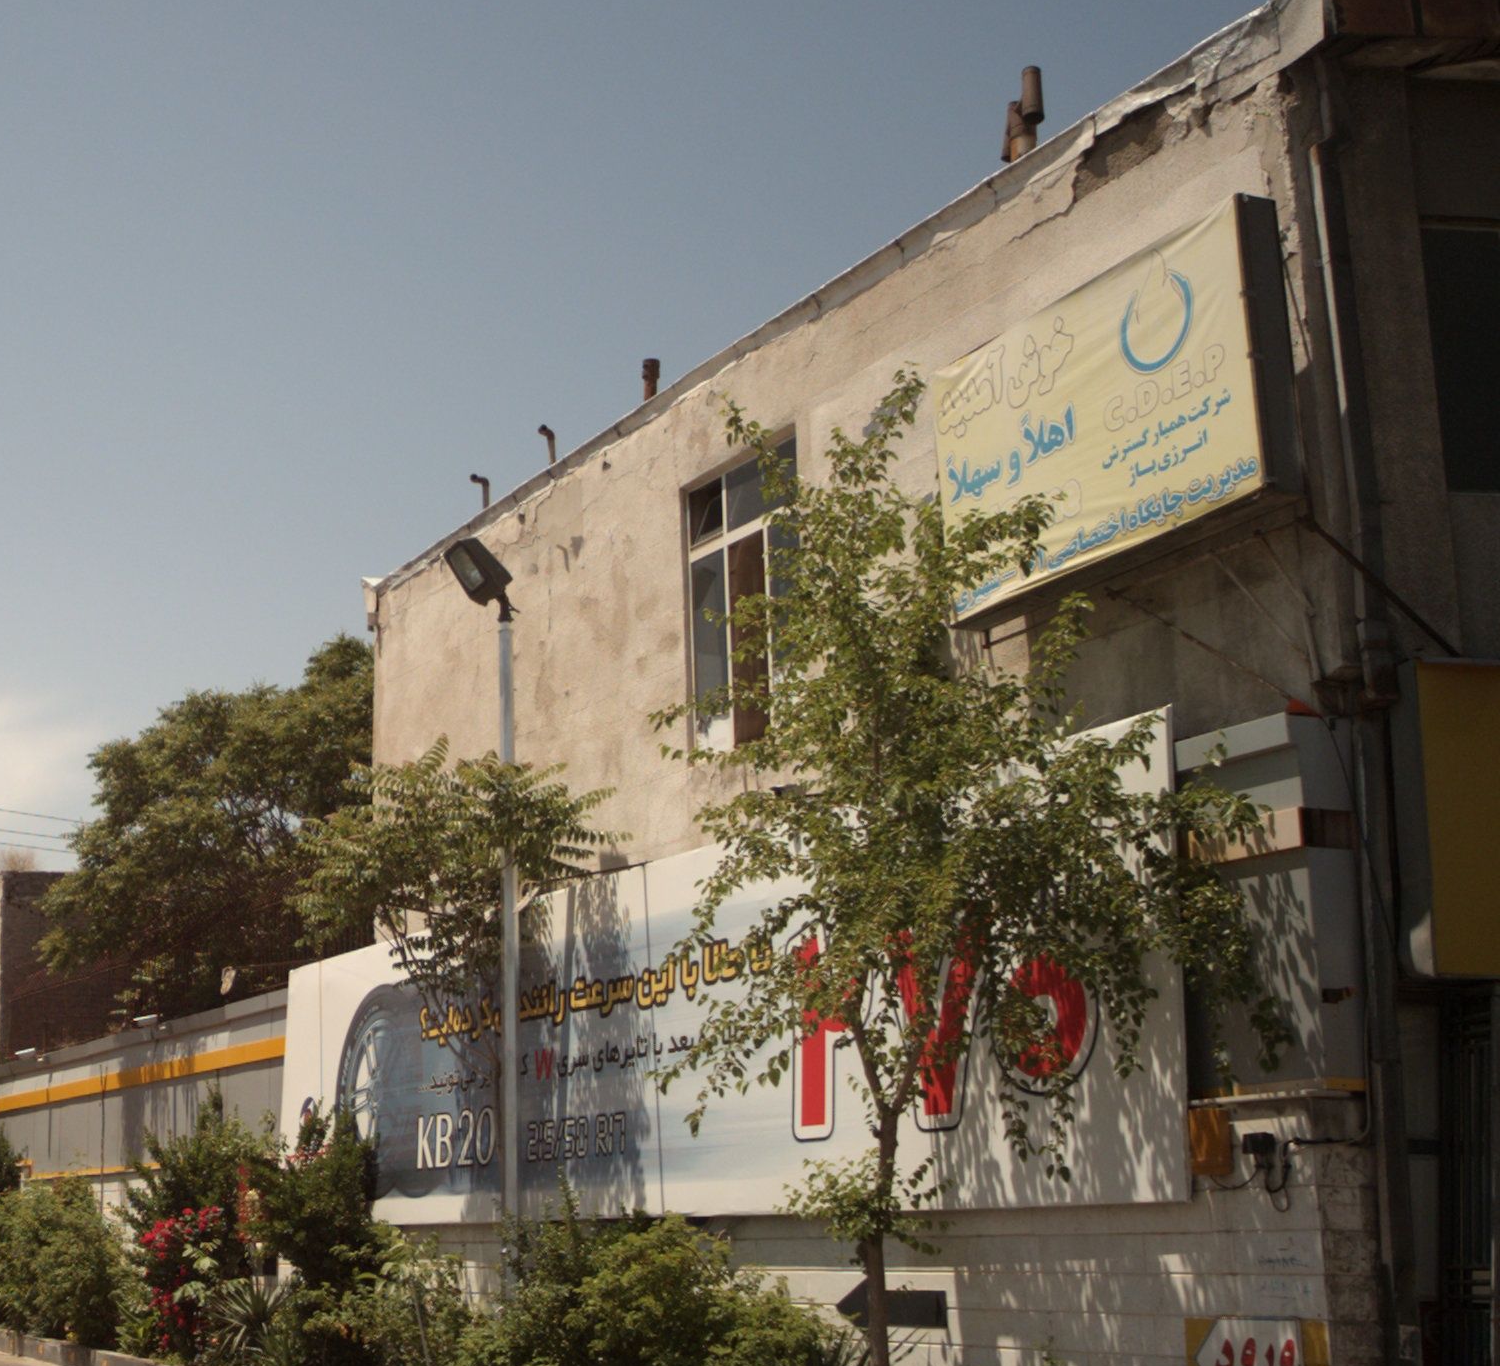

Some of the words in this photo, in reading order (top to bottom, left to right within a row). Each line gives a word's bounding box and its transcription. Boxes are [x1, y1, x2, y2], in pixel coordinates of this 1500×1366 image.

[1104, 344, 1225, 432] C.D.E.P
[1188, 388, 1231, 423] شرکت
[1152, 414, 1188, 447] همیار
[1158, 428, 1207, 472] انرژی
[1007, 450, 1022, 488] و
[1186, 458, 1258, 504] مدیریت
[1128, 487, 1185, 530] جایگاه
[1047, 508, 1127, 572] اختصاصی
[568, 971, 635, 1018] سرعت
[637, 952, 676, 1010] این
[681, 949, 699, 1001] با
[534, 1047, 555, 1083] W
[557, 1052, 589, 1078] سری
[526, 1115, 588, 1163] 215/50
[596, 1112, 626, 1157] R17
